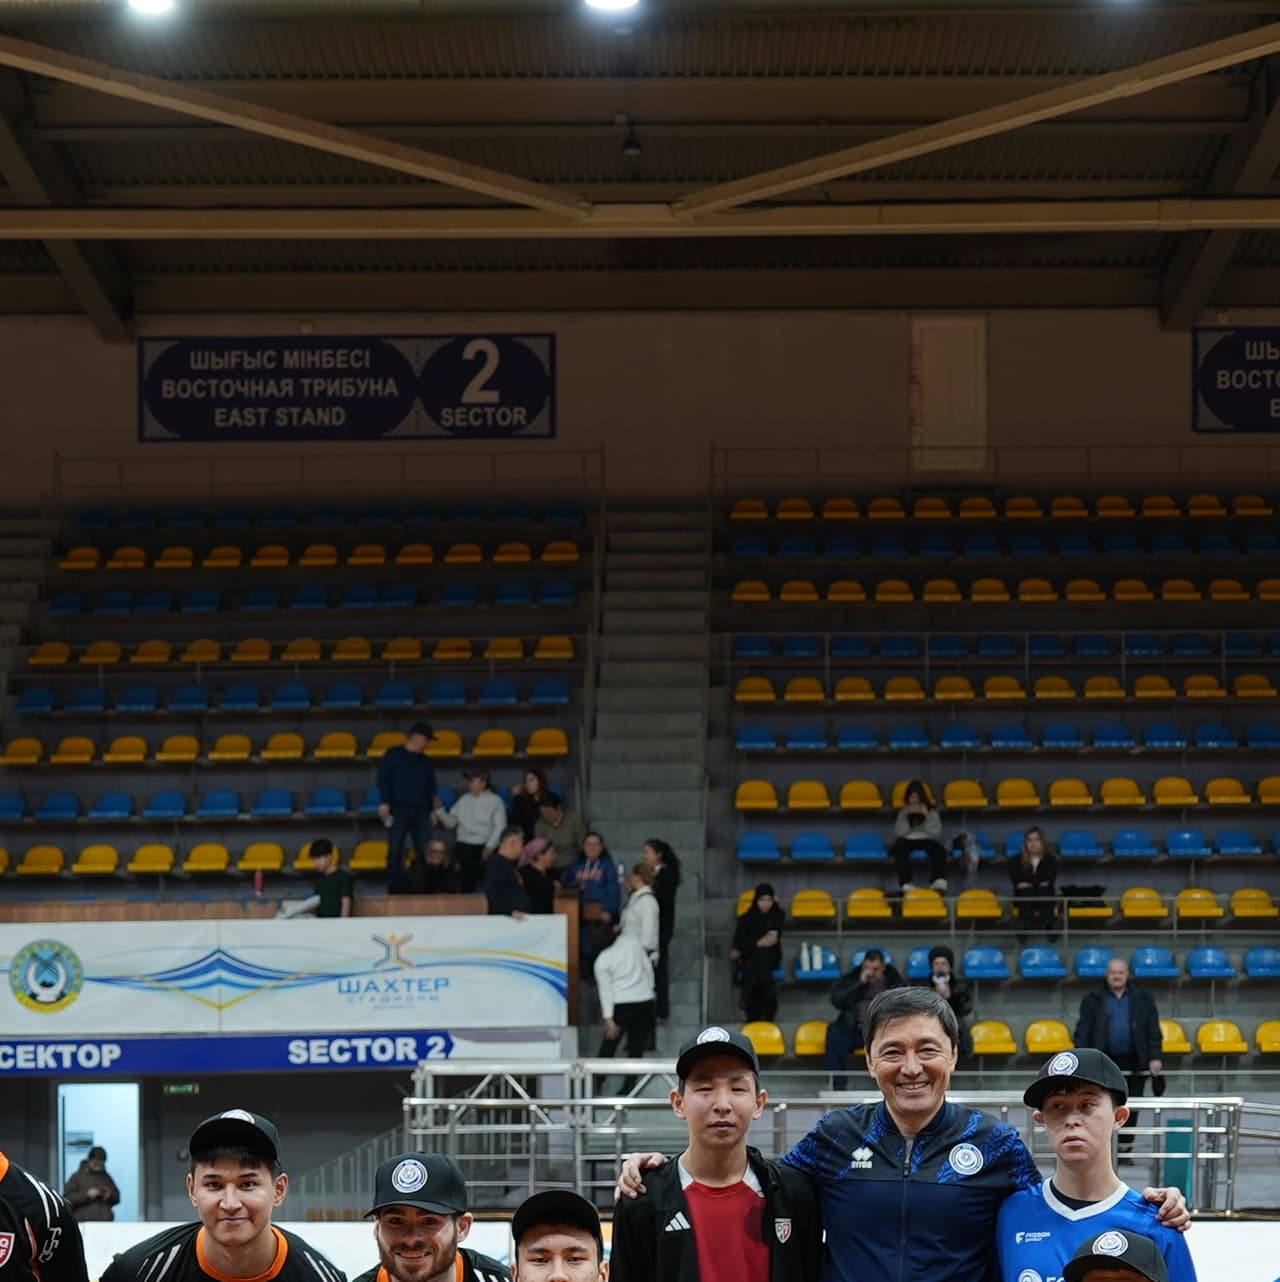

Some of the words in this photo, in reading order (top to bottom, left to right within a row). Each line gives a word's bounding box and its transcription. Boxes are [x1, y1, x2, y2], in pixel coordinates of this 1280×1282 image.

[190, 350, 277, 370] ШЫҒЫС
[283, 350, 370, 369] МІНБЕСІ
[461, 339, 500, 404] 2
[162, 379, 294, 398] ВОСТОЧНАЯ
[301, 378, 398, 398] ТРИБУНА
[214, 408, 269, 427] EAST
[275, 407, 346, 427] STAND
[440, 407, 527, 427] SECTOR
[337, 977, 450, 994] ШАХТЕР
[288, 1037, 415, 1064] SECTOR
[424, 1035, 446, 1061] 2
